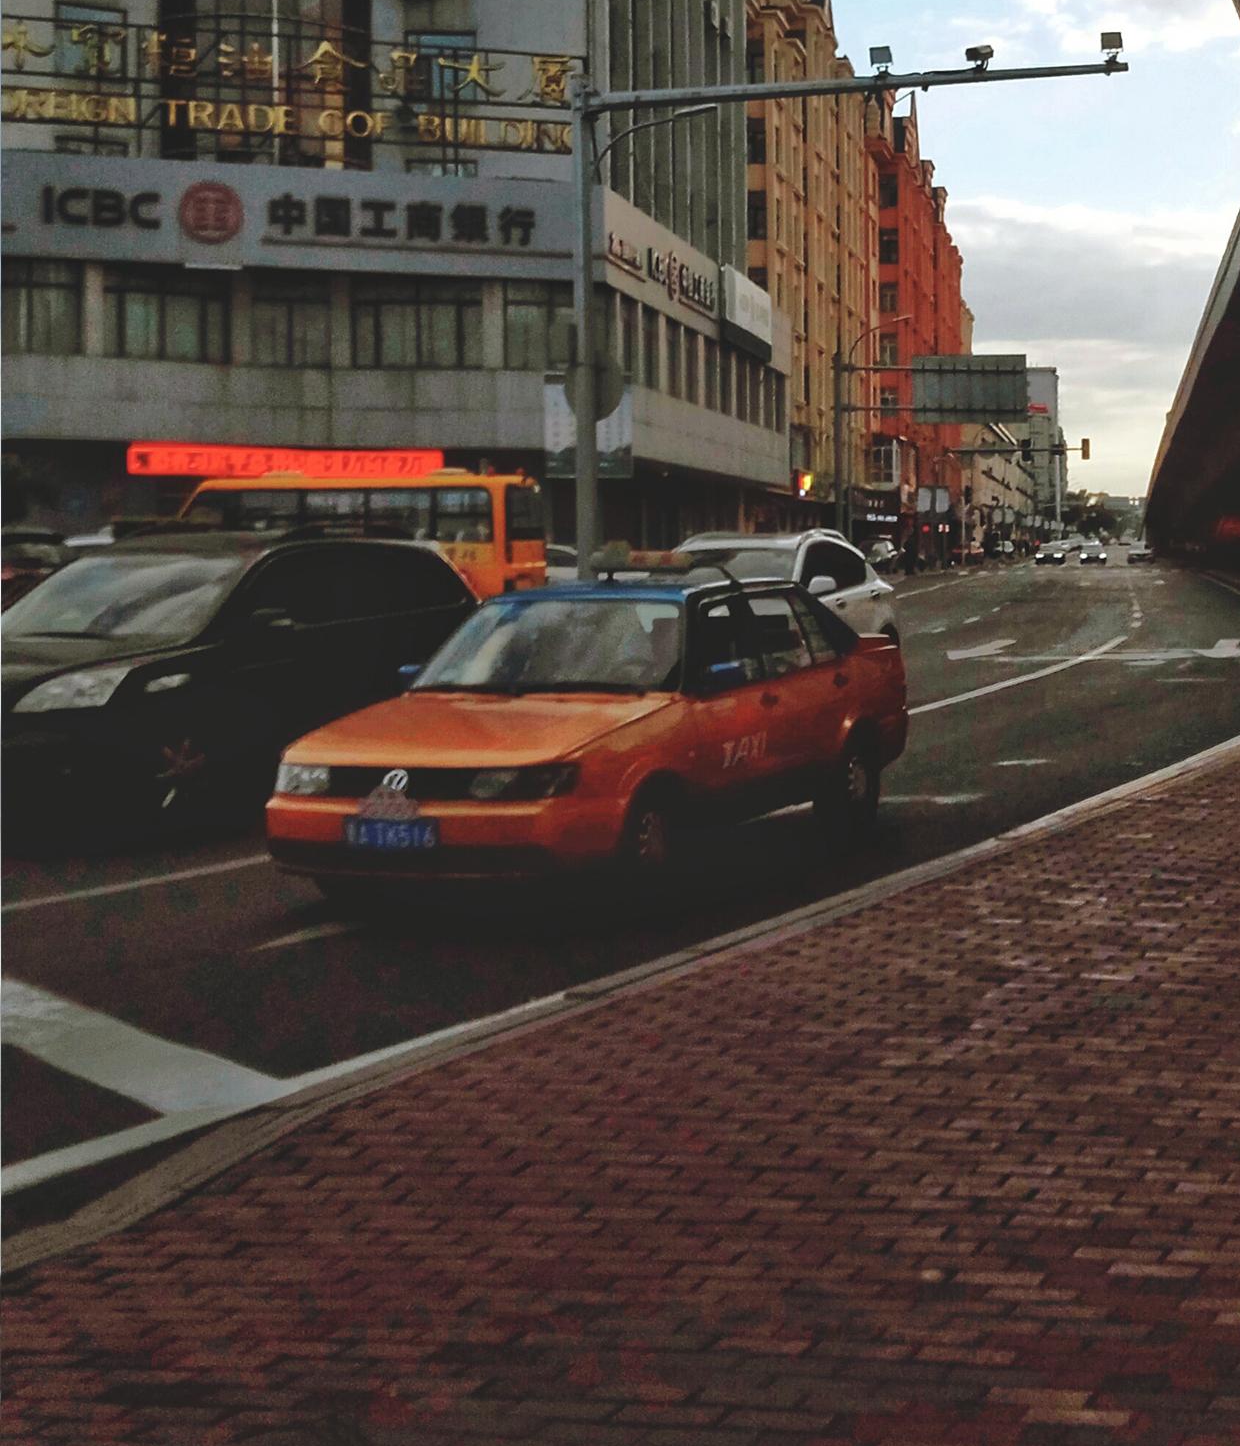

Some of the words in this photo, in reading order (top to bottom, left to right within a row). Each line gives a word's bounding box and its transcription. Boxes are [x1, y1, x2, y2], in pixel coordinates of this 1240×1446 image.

[167, 100, 297, 134] TRADE
[42, 184, 162, 230] ICBC
[267, 192, 537, 246] 中国工商银行
[722, 731, 767, 769] TAXI
